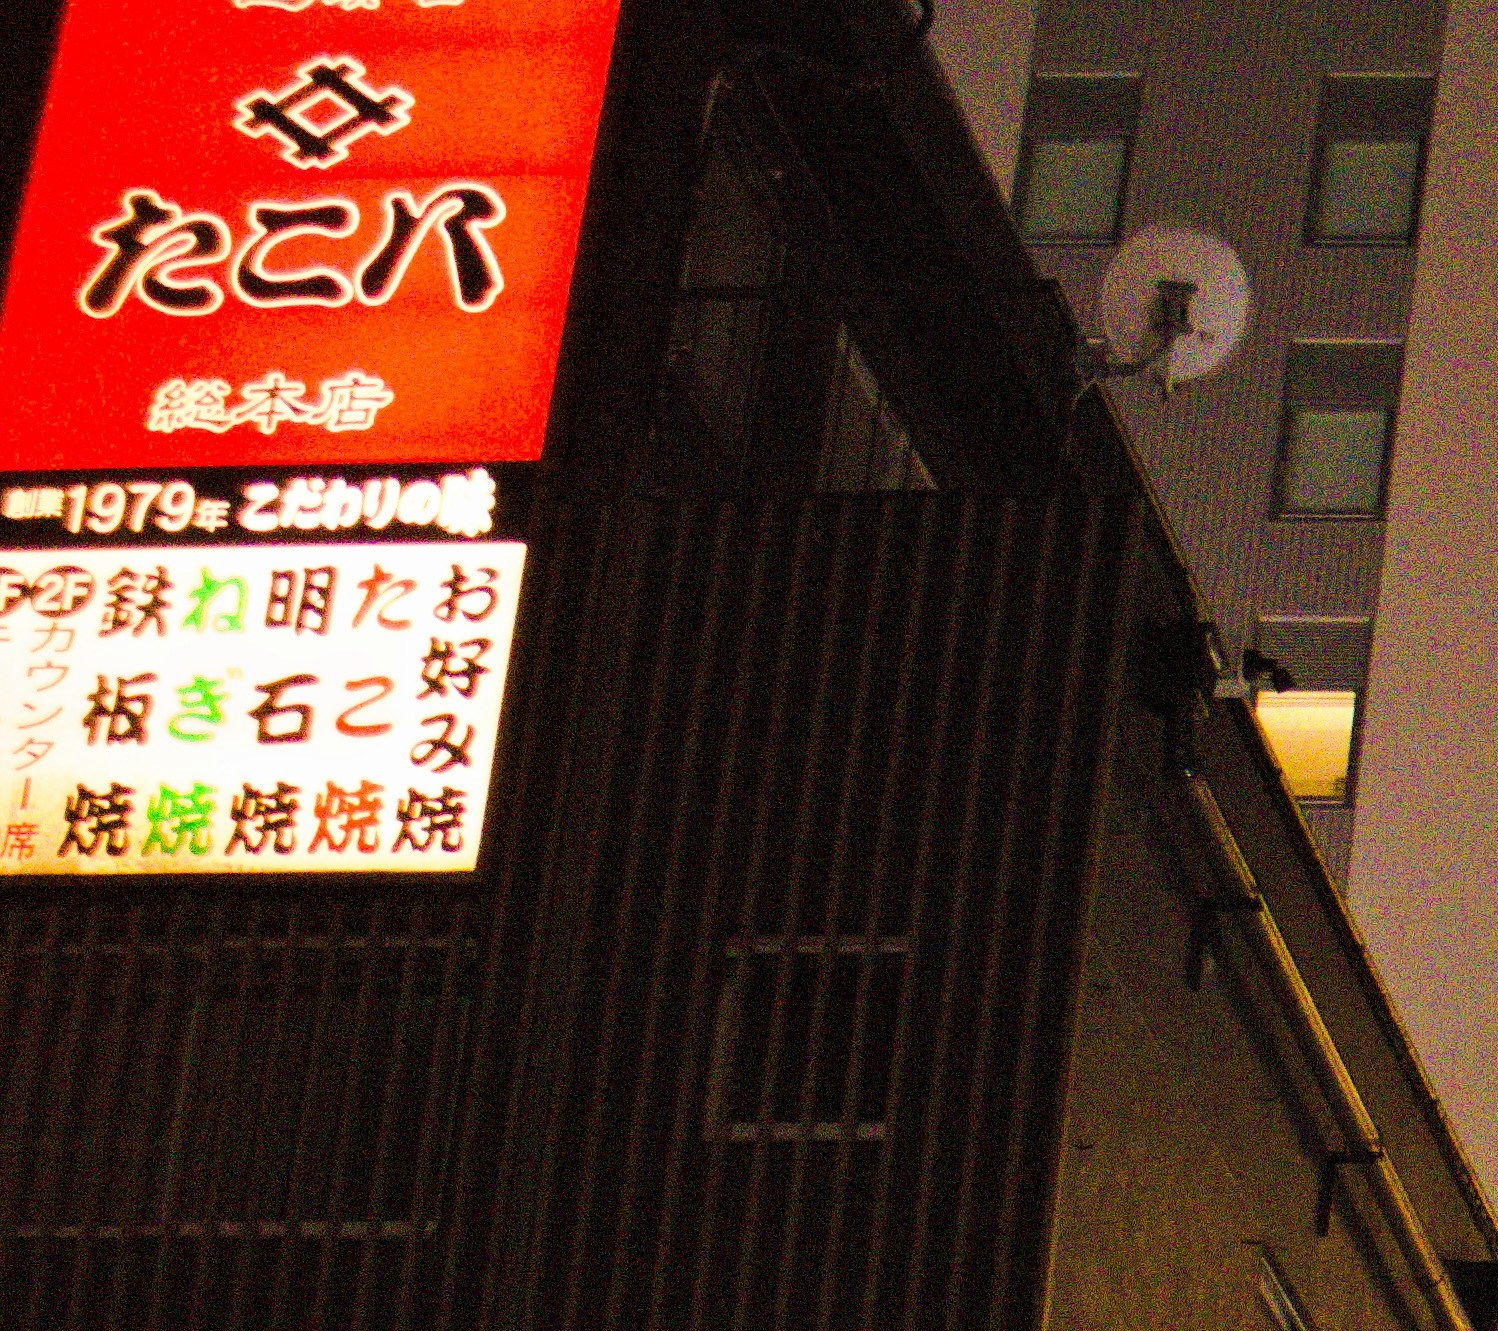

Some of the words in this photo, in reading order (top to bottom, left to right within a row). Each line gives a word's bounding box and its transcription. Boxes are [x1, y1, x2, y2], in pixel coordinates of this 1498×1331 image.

[39, 572, 92, 612] 2F
[58, 564, 176, 858] 鉄板焼
[141, 566, 248, 856] ねぎ焼
[224, 564, 338, 856] 明石焼
[308, 562, 417, 855] たこ焼
[391, 563, 500, 855] お好み焼
[1, 621, 75, 861] カウンター席
